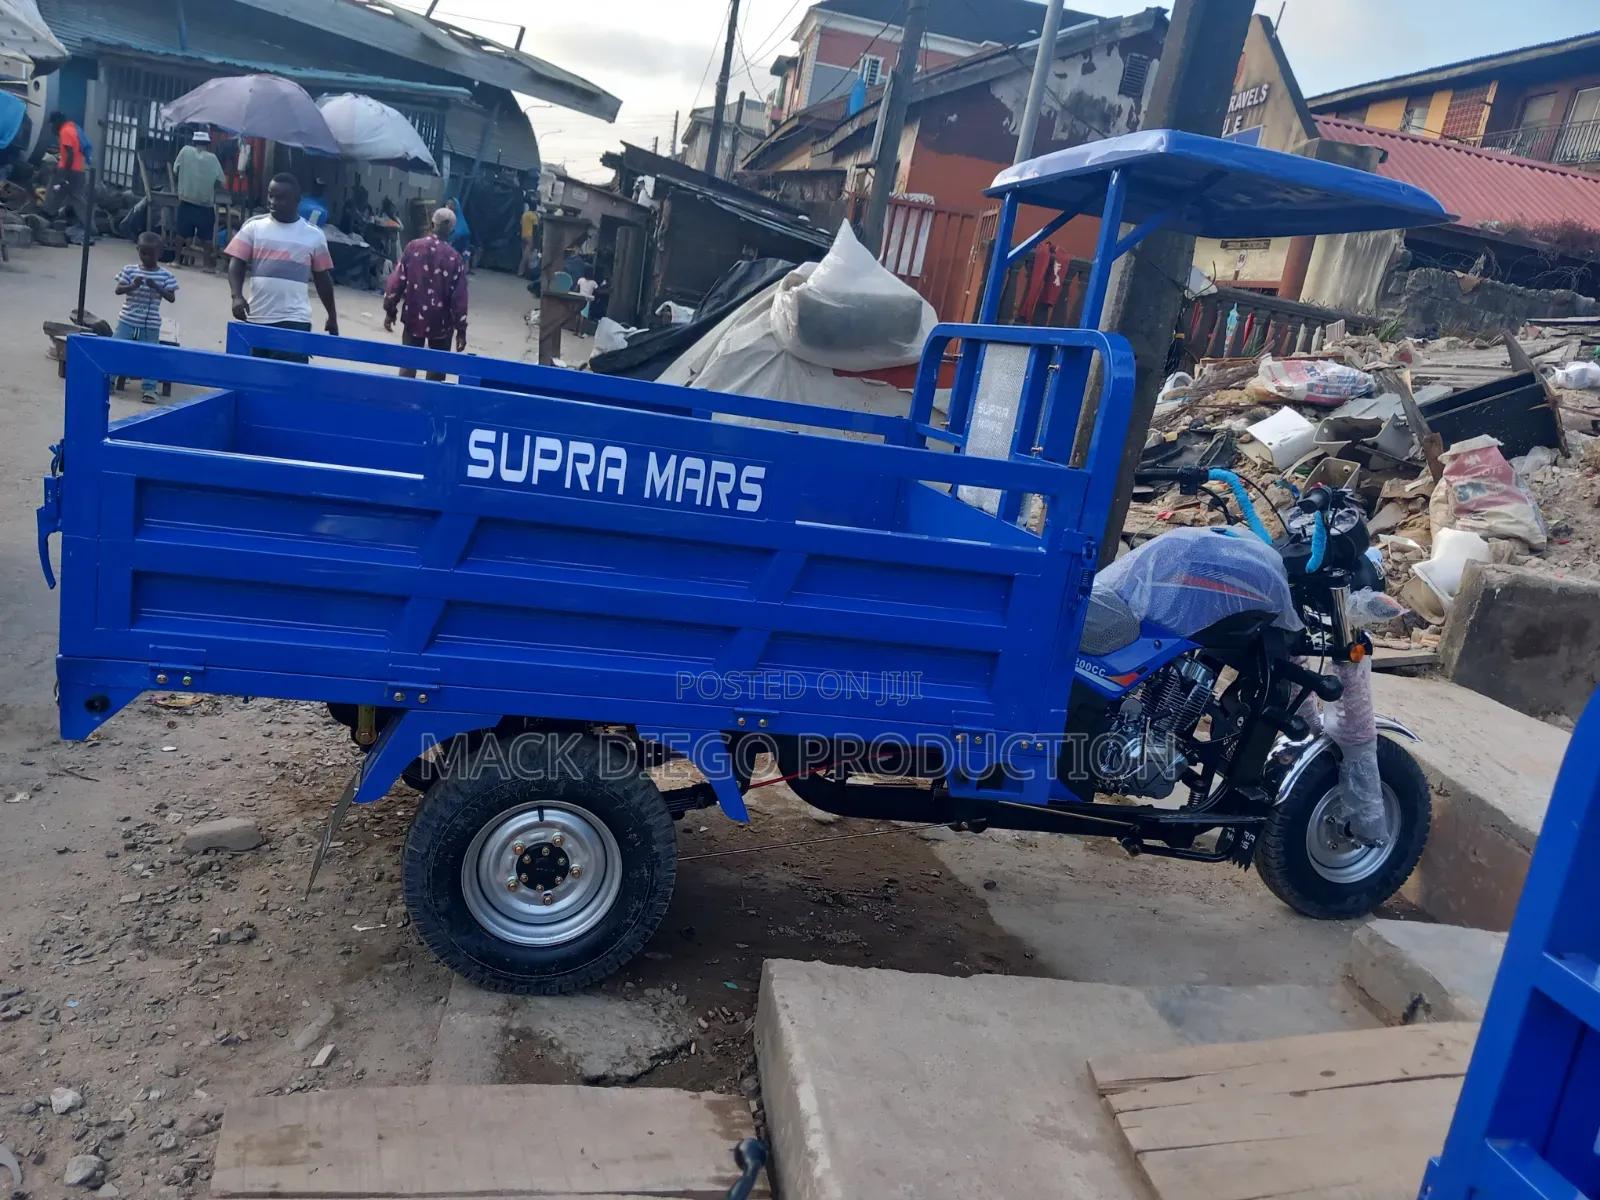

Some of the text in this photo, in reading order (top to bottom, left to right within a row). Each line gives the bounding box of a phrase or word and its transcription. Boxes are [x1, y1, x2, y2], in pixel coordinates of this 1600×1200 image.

[1228, 84, 1268, 113] RAVELS
[466, 428, 766, 513] SUPRA MARS
